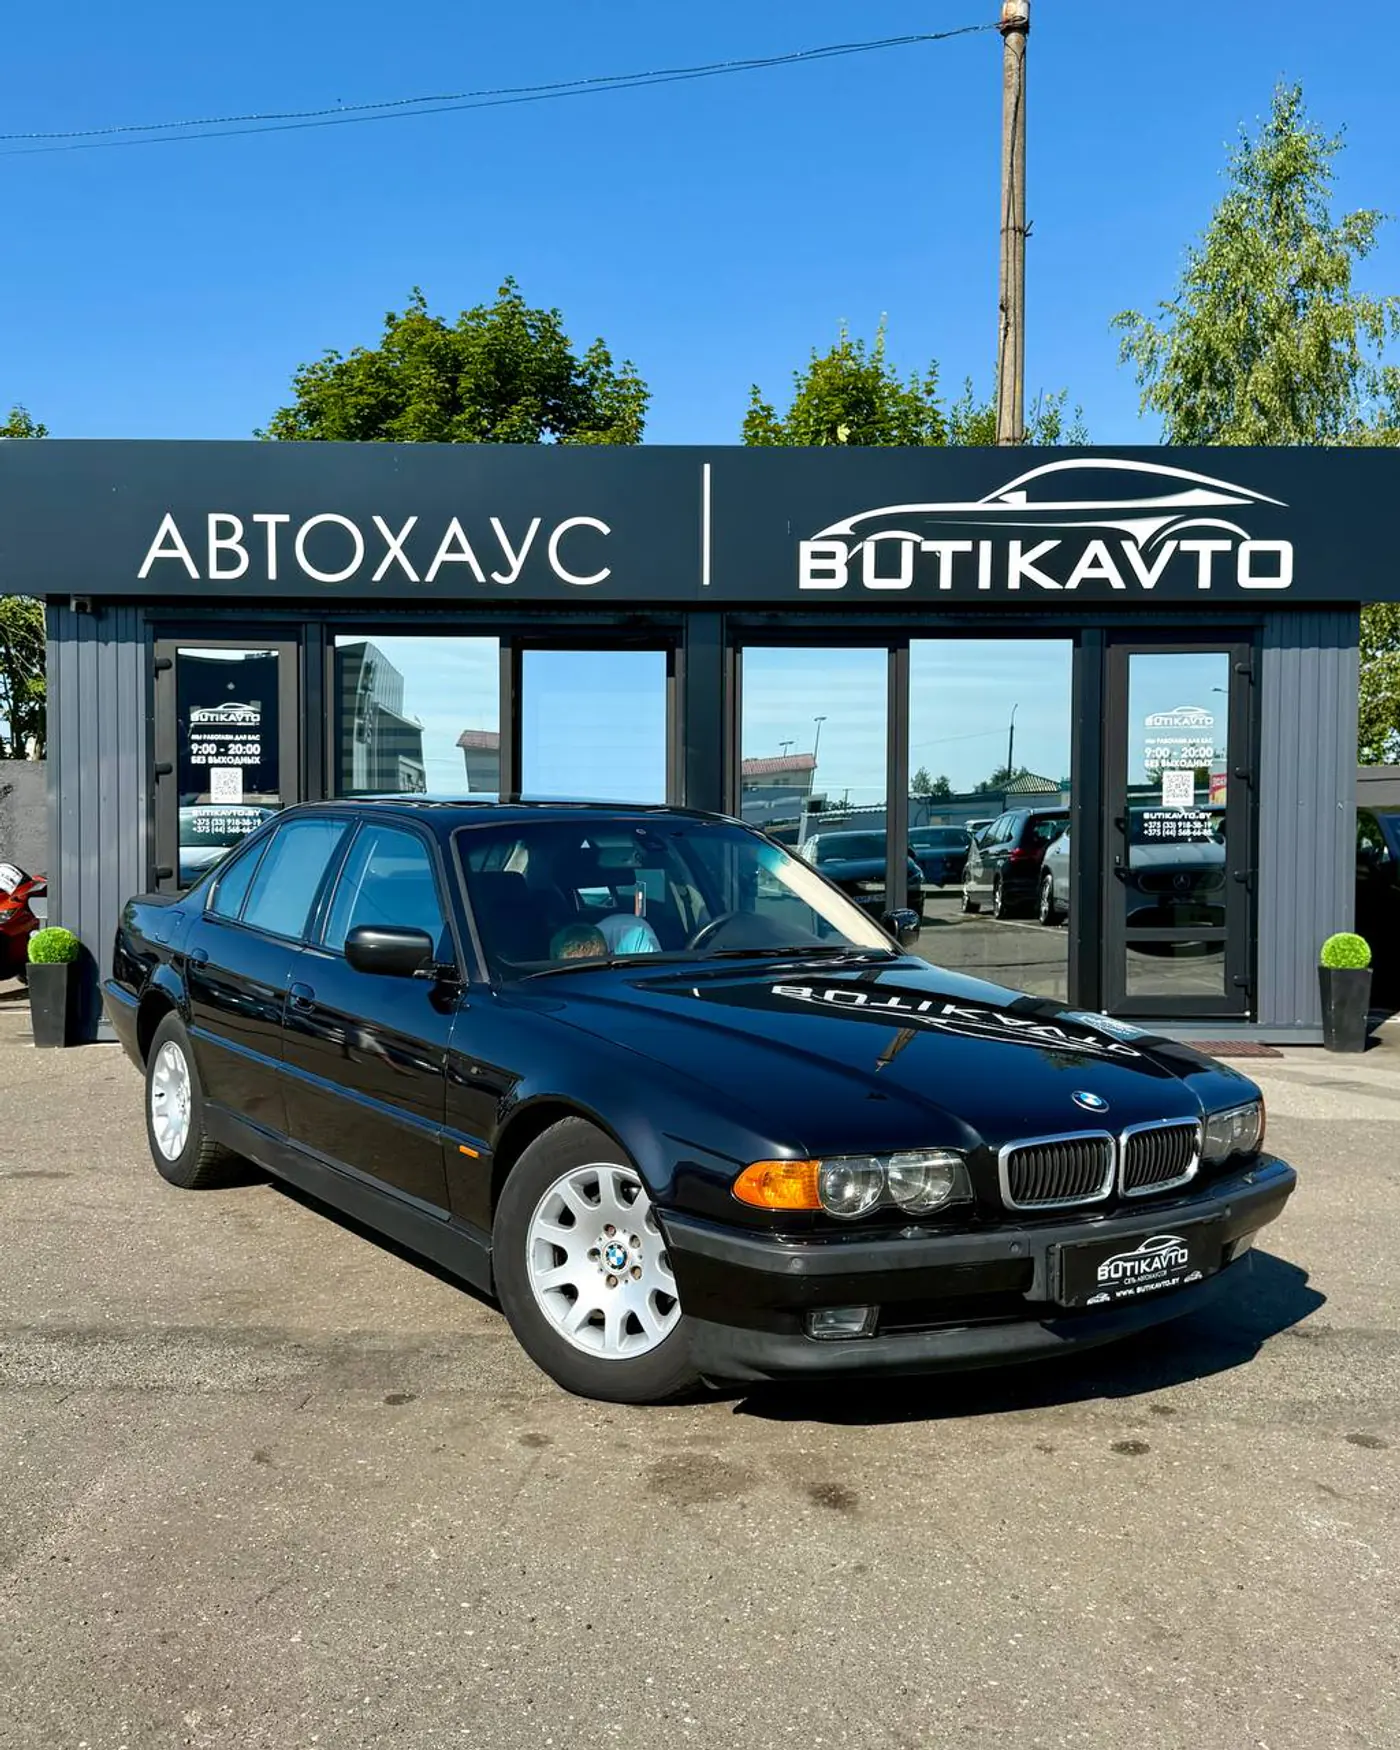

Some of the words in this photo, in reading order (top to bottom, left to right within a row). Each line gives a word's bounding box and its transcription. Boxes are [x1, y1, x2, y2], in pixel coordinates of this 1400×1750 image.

[137, 512, 611, 585] АВТОХАУС
[798, 539, 1293, 590] BUTIKAVTO
[191, 713, 260, 721] BUTIKAVTO
[1145, 717, 1214, 726] BUTIKAVTO
[191, 743, 217, 754] 9:00
[228, 743, 260, 754] 20:00
[1144, 747, 1170, 758] 9:00
[1181, 747, 1214, 758] 20:00
[191, 756, 206, 764] БЕЗ
[208, 756, 260, 765] ВЫХОДНЫХ
[1161, 759, 1213, 767] ВЫХОДНЫХ
[1143, 821, 1161, 829] +375
[1097, 1249, 1188, 1281] BUTIKAVTO
